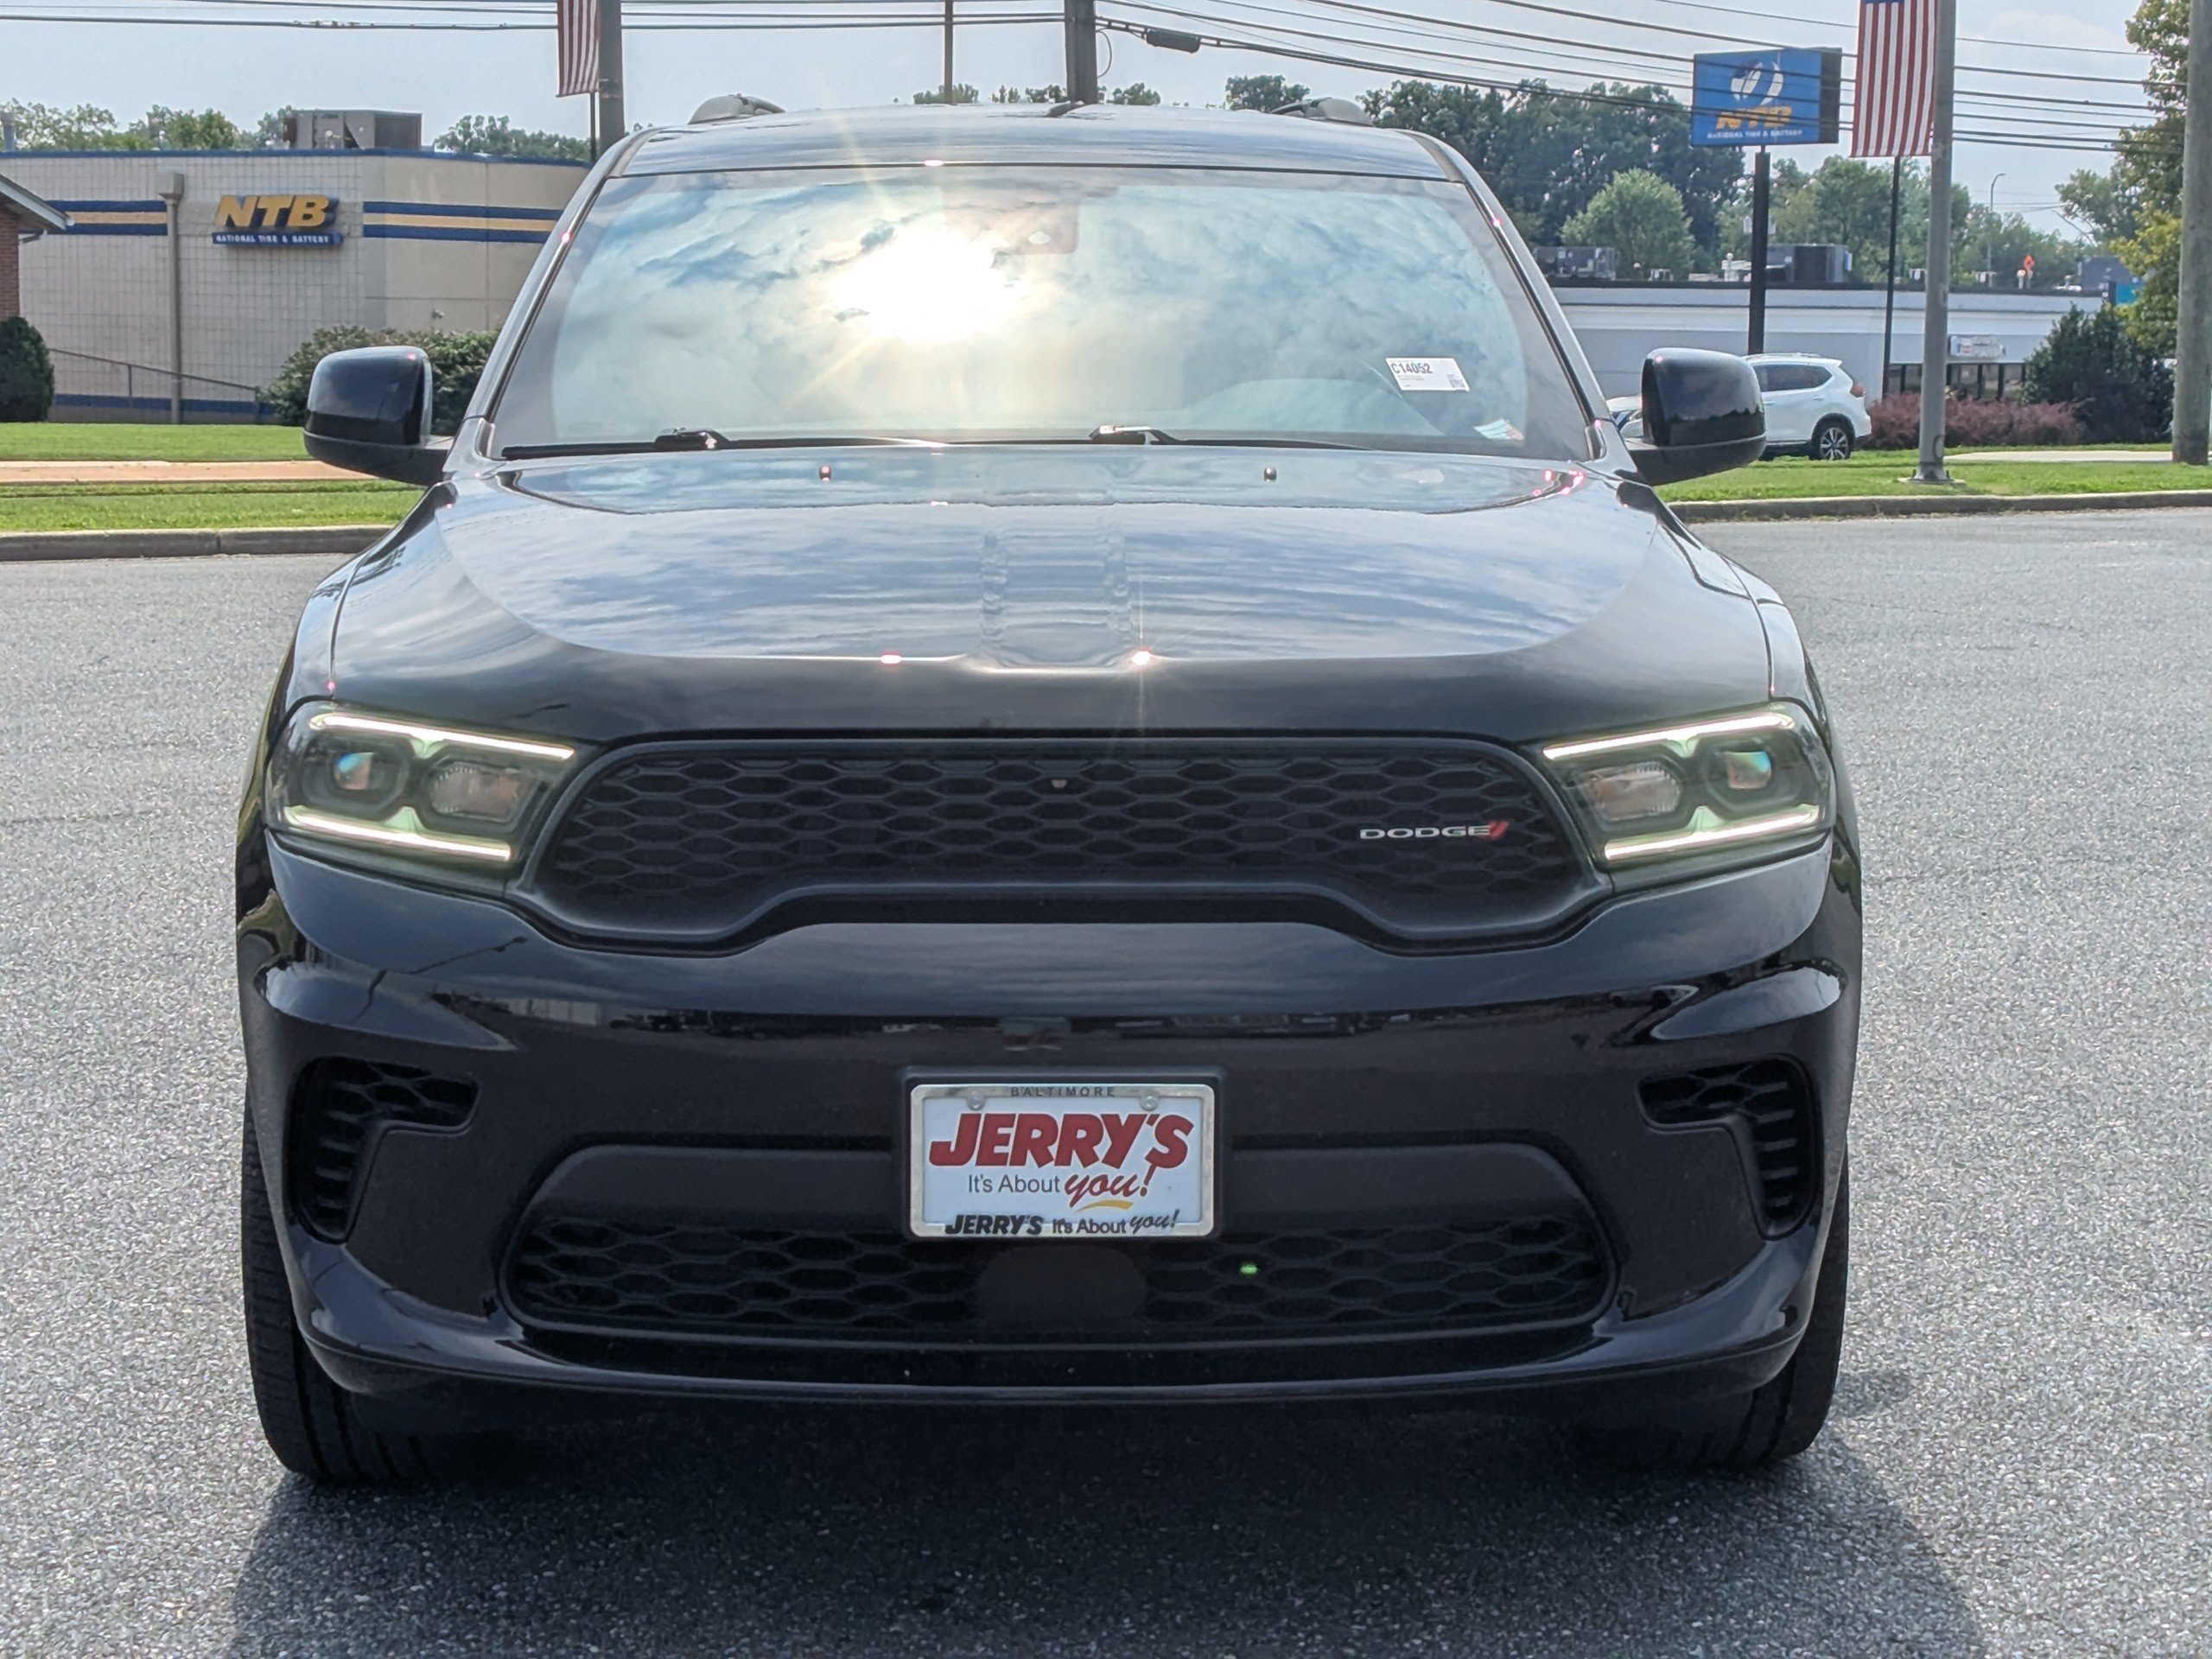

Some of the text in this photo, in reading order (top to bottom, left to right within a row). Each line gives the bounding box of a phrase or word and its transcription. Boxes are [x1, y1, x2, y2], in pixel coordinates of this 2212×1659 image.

[1716, 105, 1792, 130] NTB
[214, 194, 330, 227] NTB
[1390, 362, 1433, 374] C14052
[1360, 824, 1491, 839] DODGE
[1010, 1086, 1116, 1097] BALTIMORE
[929, 1113, 1194, 1169] JERRY'S
[968, 1164, 1158, 1208] It's About you!
[945, 1209, 1180, 1235] JERRY'S It's About you!
